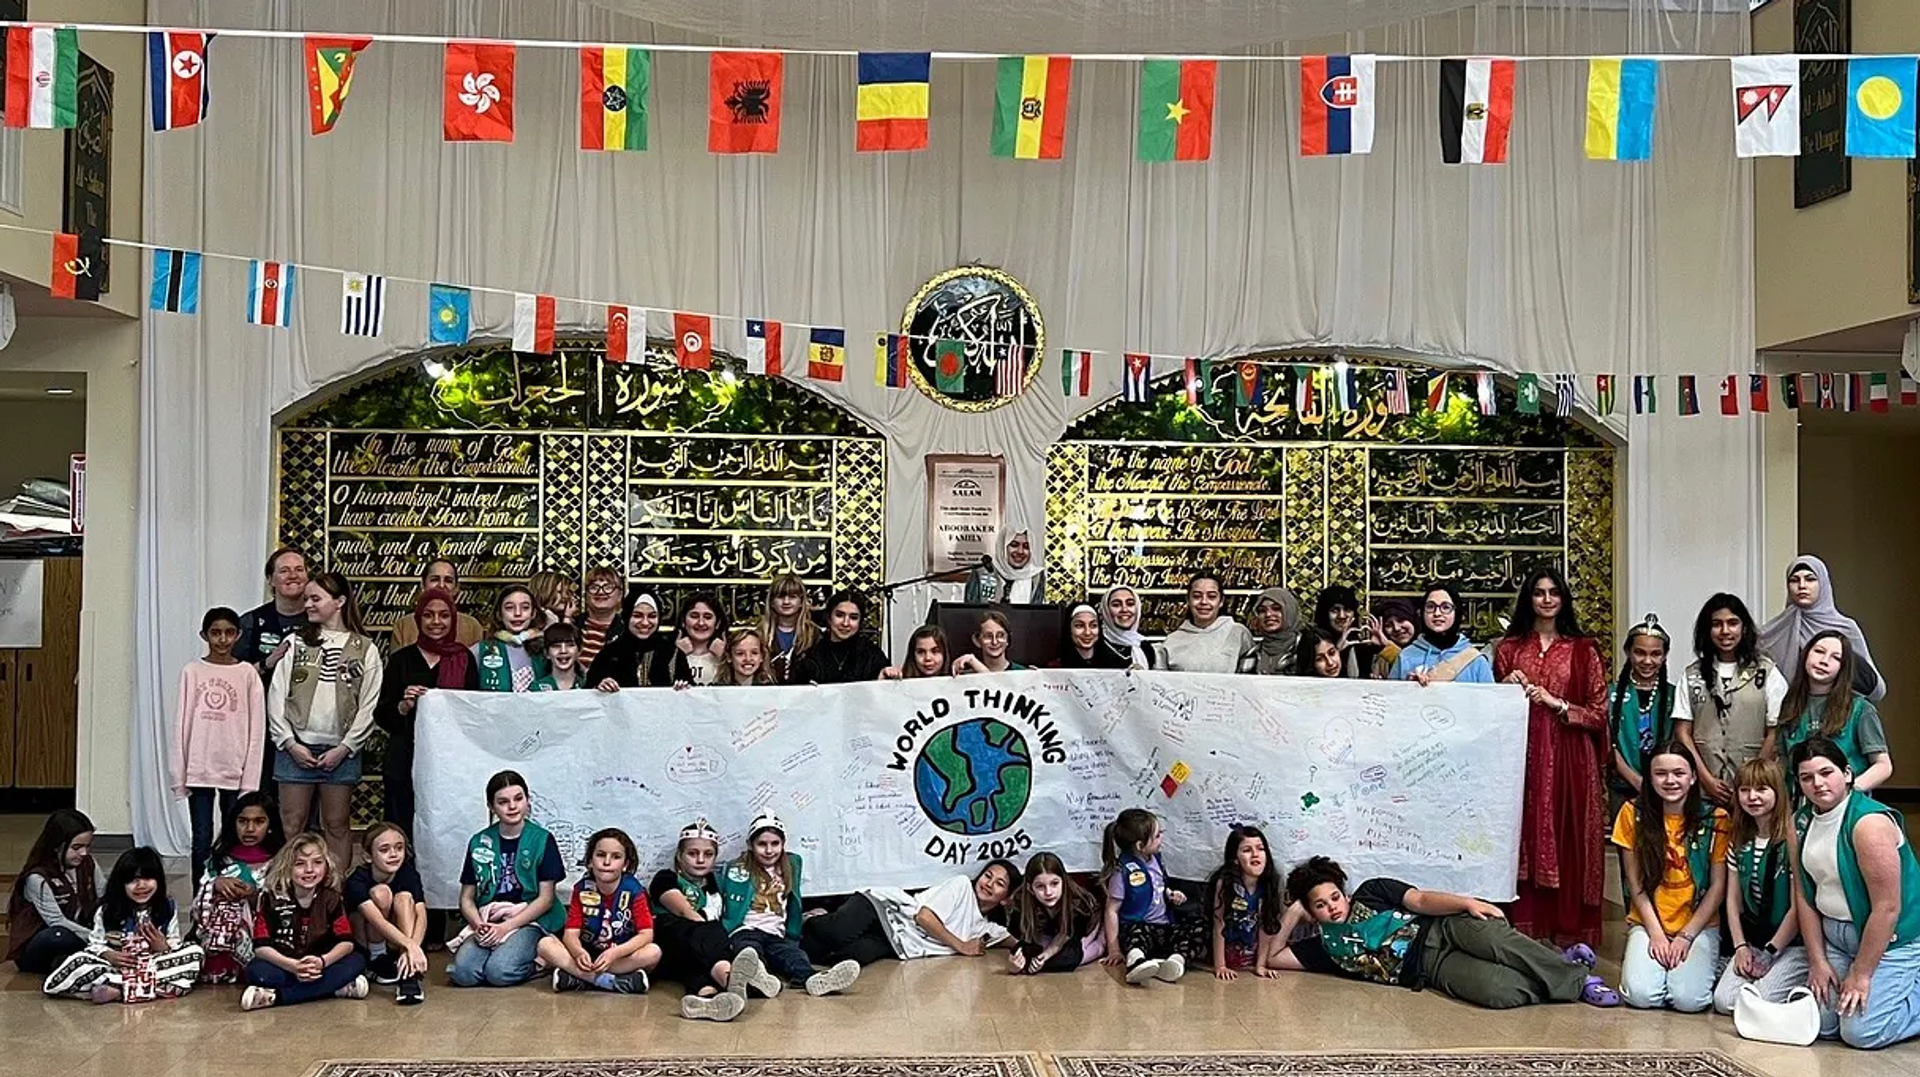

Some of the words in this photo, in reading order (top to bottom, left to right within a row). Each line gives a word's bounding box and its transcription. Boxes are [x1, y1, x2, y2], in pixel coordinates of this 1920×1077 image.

[391, 434, 417, 456] the
[466, 435, 488, 461] of
[422, 453, 450, 475] the
[1128, 450, 1148, 469] the
[1168, 472, 1192, 491] the
[333, 484, 350, 505] O
[338, 504, 376, 526] have
[513, 511, 529, 527] a
[378, 533, 415, 556] and
[417, 541, 431, 556] a
[492, 533, 528, 556] and
[501, 554, 536, 577] and
[1092, 548, 1112, 567] the
[1092, 567, 1112, 586] the
[382, 583, 418, 606] that
[887, 698, 950, 771] WORLD
[964, 689, 1067, 764] THINKING
[924, 835, 971, 865] DAY
[977, 829, 1033, 861] 2025
